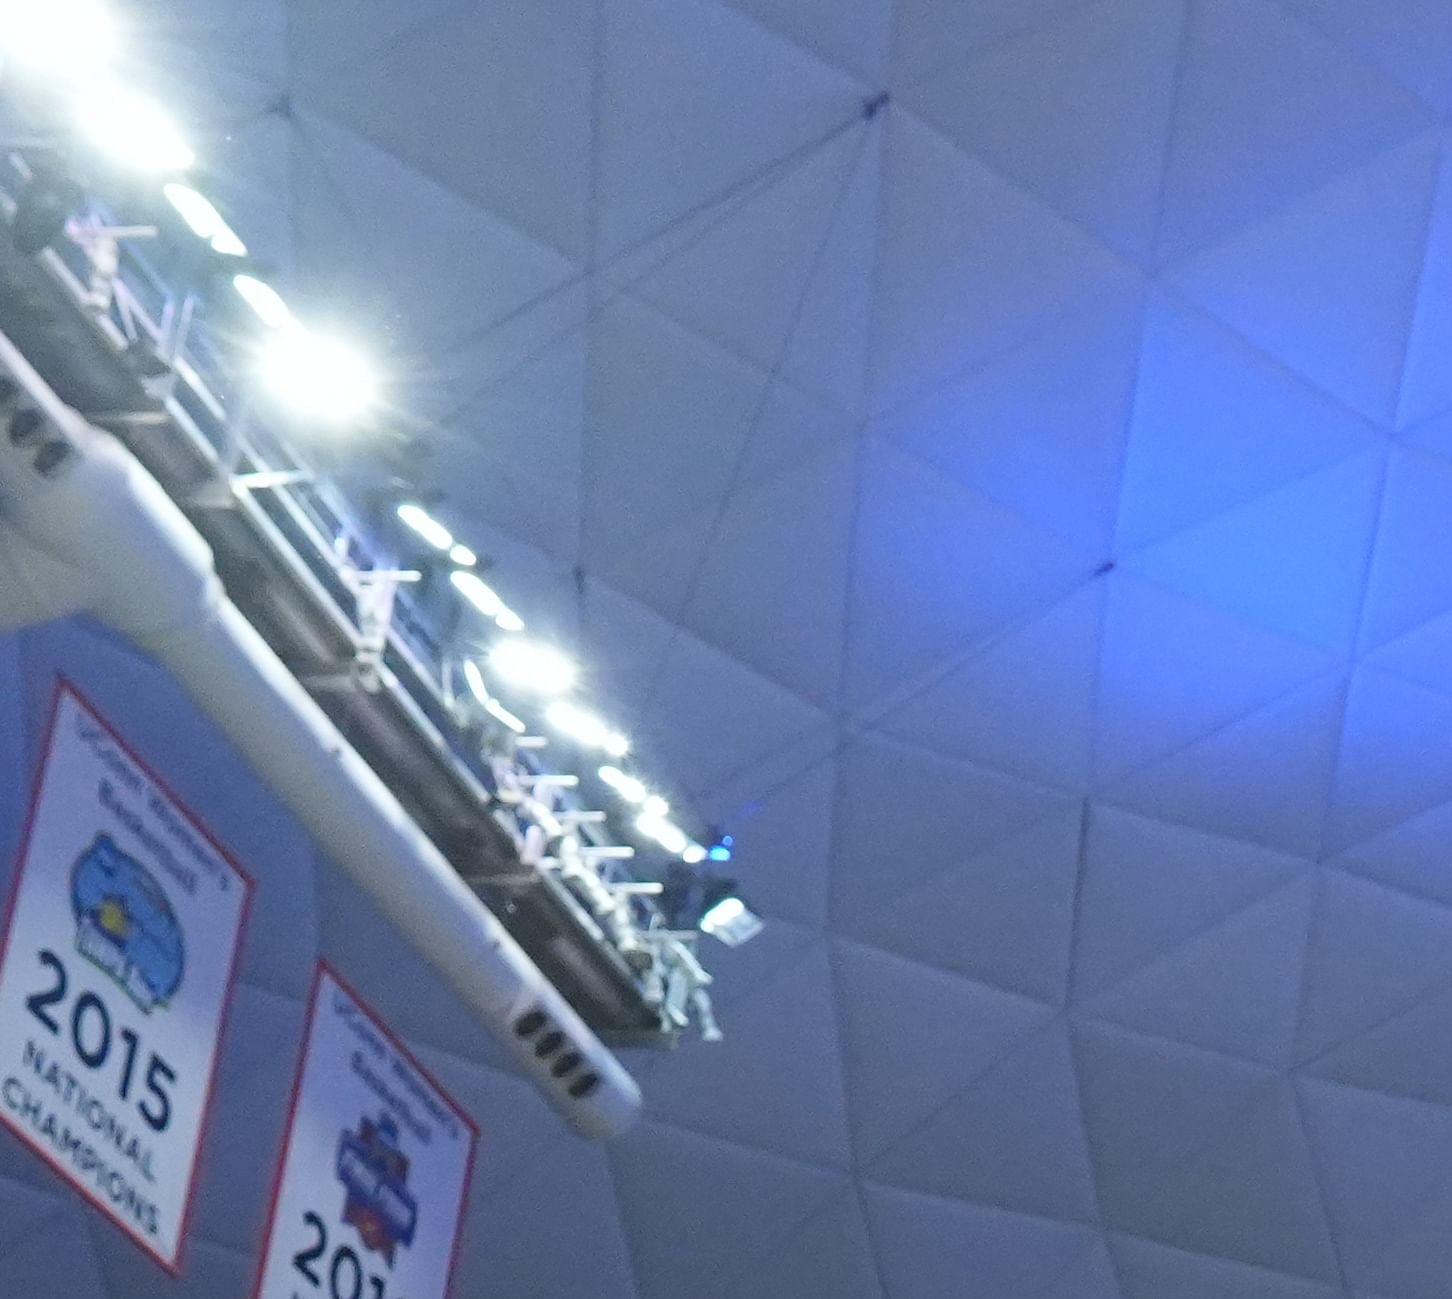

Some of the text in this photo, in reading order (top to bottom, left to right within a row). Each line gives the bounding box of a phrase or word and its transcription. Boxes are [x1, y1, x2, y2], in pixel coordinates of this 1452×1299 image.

[22, 1038, 158, 1184] NATIONAL
[26, 947, 178, 1134] 2015
[2, 1074, 161, 1236] CHAMPIONS
